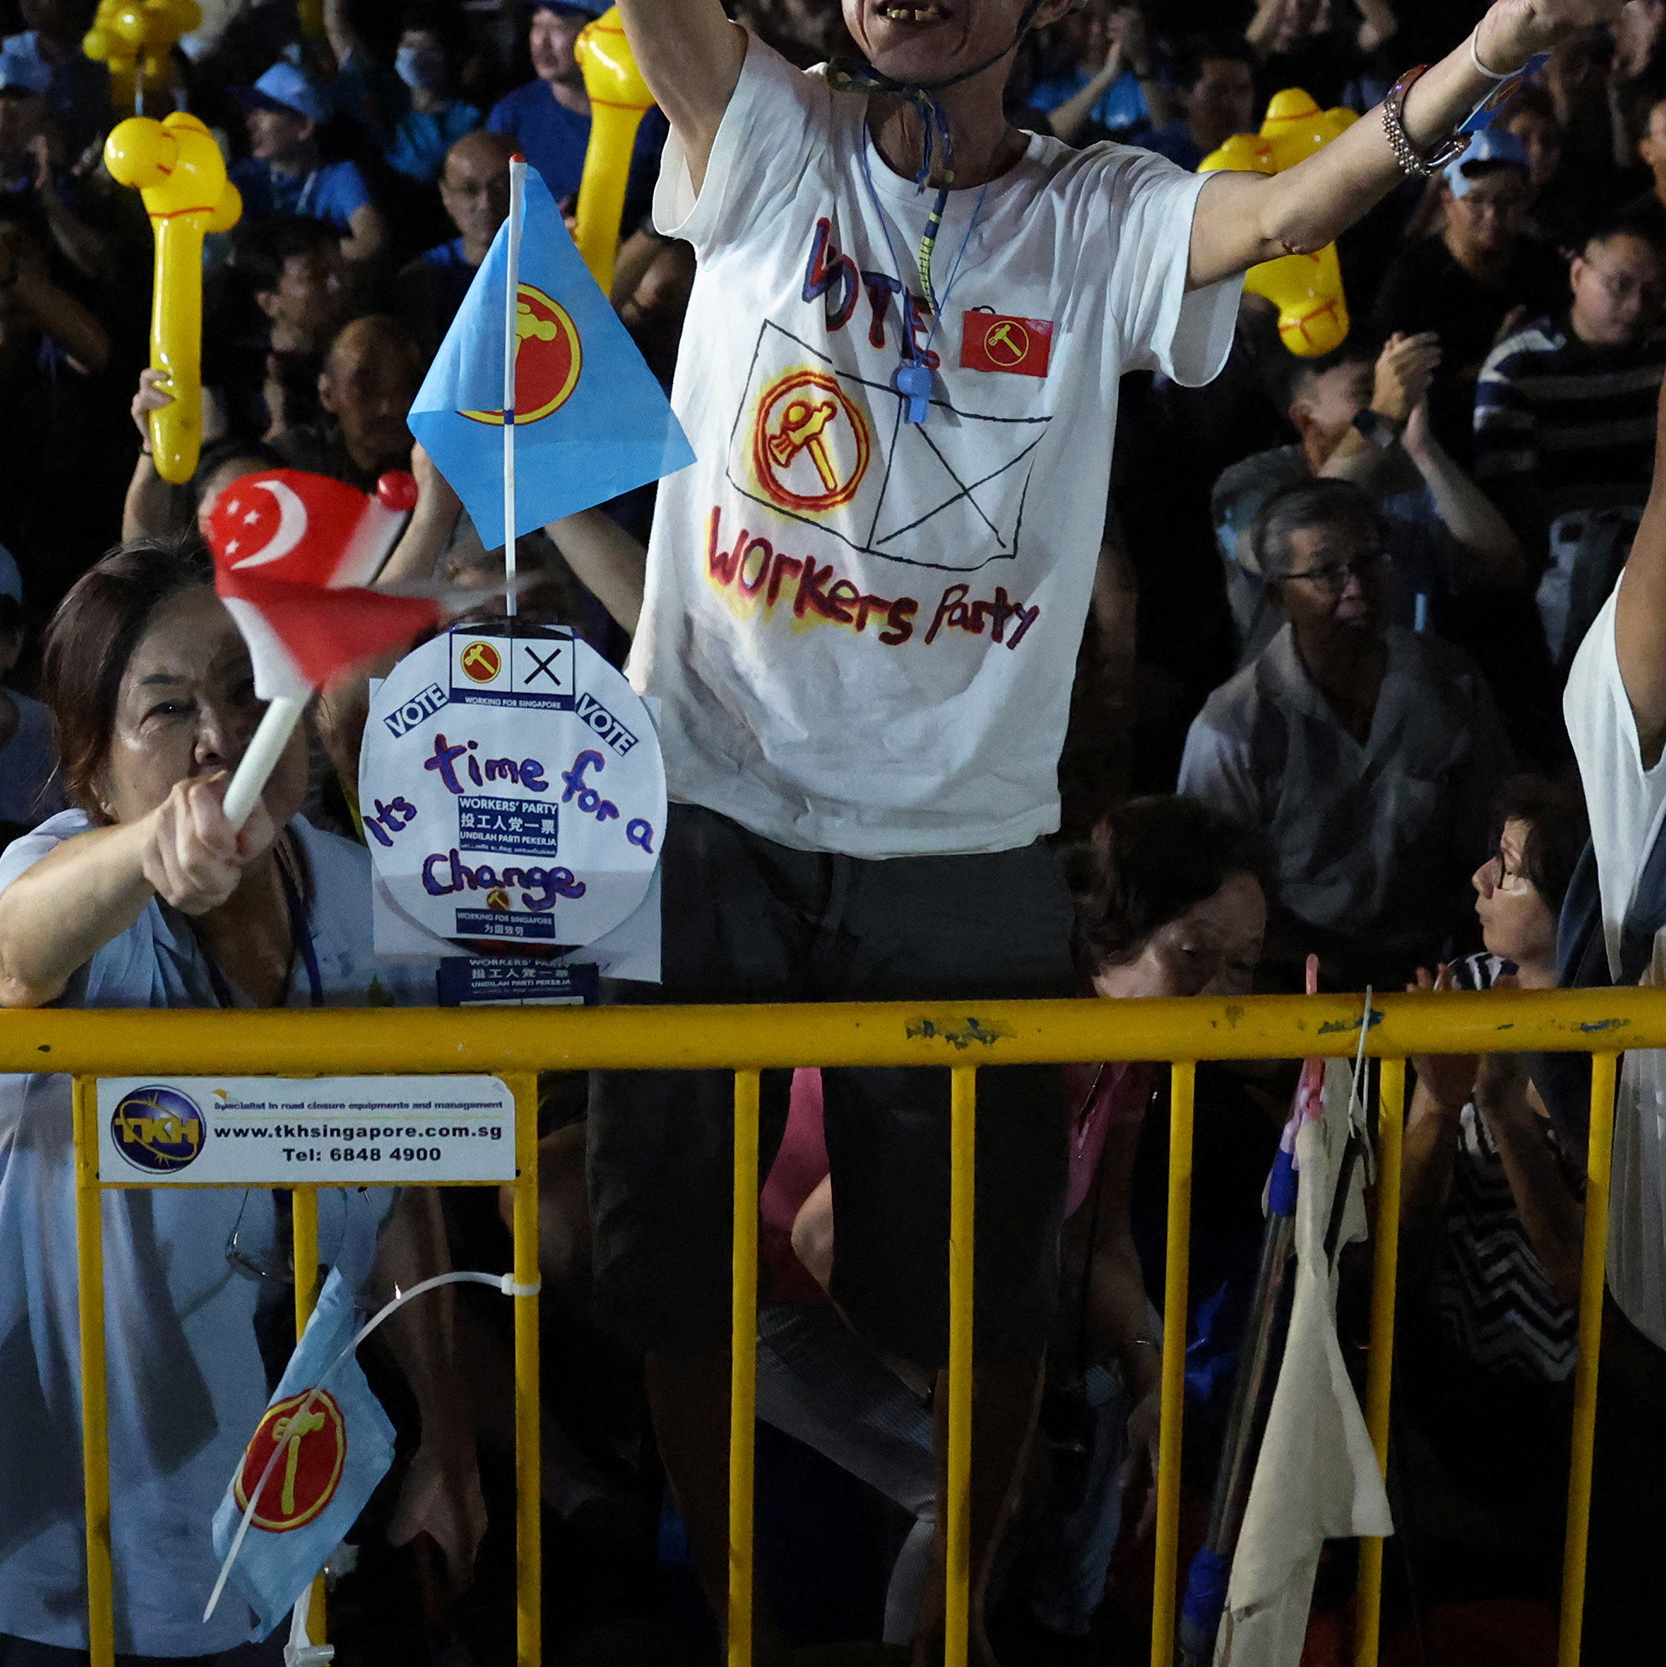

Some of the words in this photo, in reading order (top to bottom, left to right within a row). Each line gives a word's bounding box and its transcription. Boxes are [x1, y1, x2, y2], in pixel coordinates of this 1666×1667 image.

[802, 217, 940, 371] VOTE
[925, 583, 1040, 650] Party
[385, 683, 449, 737] VOTE
[465, 697, 501, 706] WORKING
[502, 699, 517, 707] FOR
[519, 700, 561, 709] SINGAPORE
[577, 693, 636, 756] VOTE
[364, 797, 417, 847] Its
[425, 733, 549, 794] time
[562, 750, 620, 821] for
[626, 818, 654, 853] a
[459, 797, 520, 812] WORKERS'
[522, 803, 558, 815] PARTY
[460, 812, 555, 835] 投工人党一票
[460, 832, 497, 841] UNDILAH
[498, 834, 520, 843] PARTI
[522, 836, 557, 846] PEKERJA
[422, 849, 586, 912] Change
[457, 912, 494, 921] WORKING
[495, 914, 510, 922] FOR
[281, 1102, 305, 1110] road
[307, 1101, 346, 1110] closure
[348, 1101, 410, 1111] equipments
[412, 1101, 432, 1110] and
[434, 1101, 503, 1111] management
[114, 1117, 200, 1144] TKH
[213, 1124, 502, 1141] www.tkhsingapore.com.sg
[282, 1147, 322, 1162] Tel:
[330, 1147, 382, 1162] 6848
[389, 1147, 442, 1162] 4900
